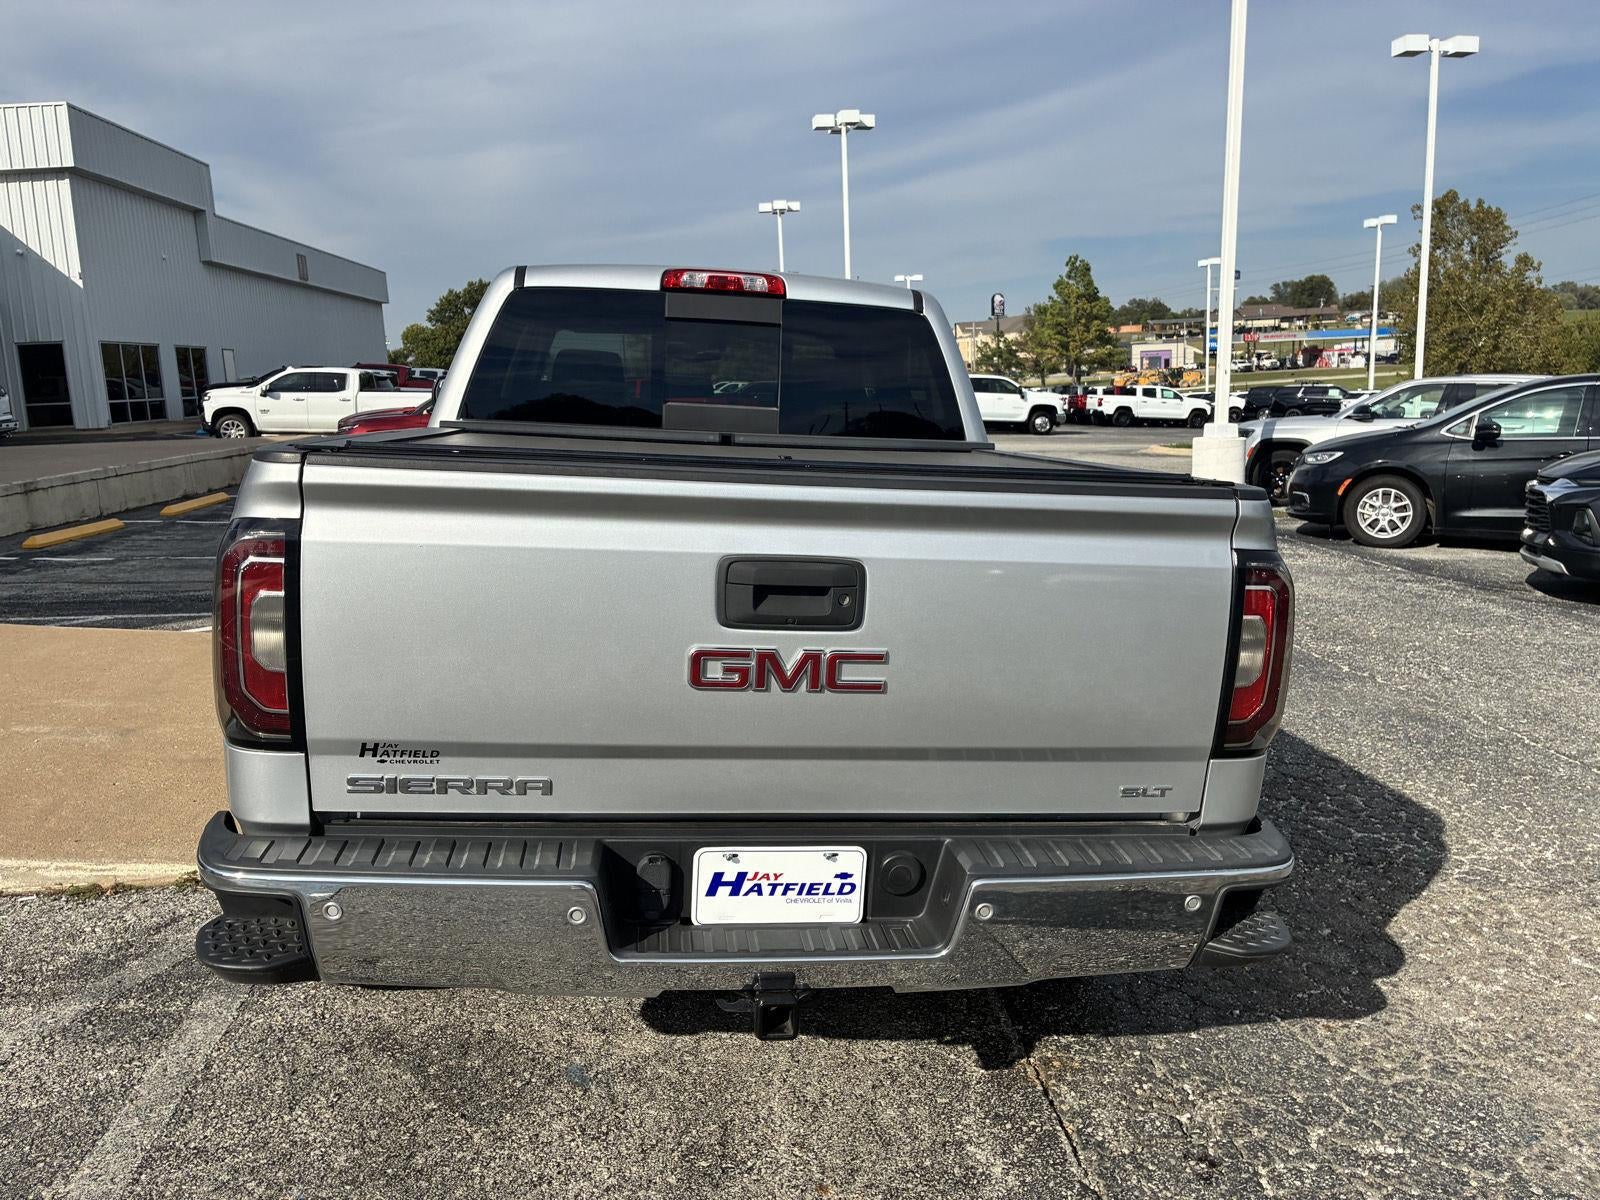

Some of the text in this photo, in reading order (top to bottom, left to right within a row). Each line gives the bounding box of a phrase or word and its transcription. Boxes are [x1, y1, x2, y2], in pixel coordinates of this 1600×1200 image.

[687, 645, 889, 694] GMC
[359, 742, 440, 758] HATFIELD
[346, 775, 553, 796] SIERRA
[1119, 784, 1173, 798] SLT
[705, 872, 857, 897] HATFIELD
[747, 872, 784, 881] JAY
